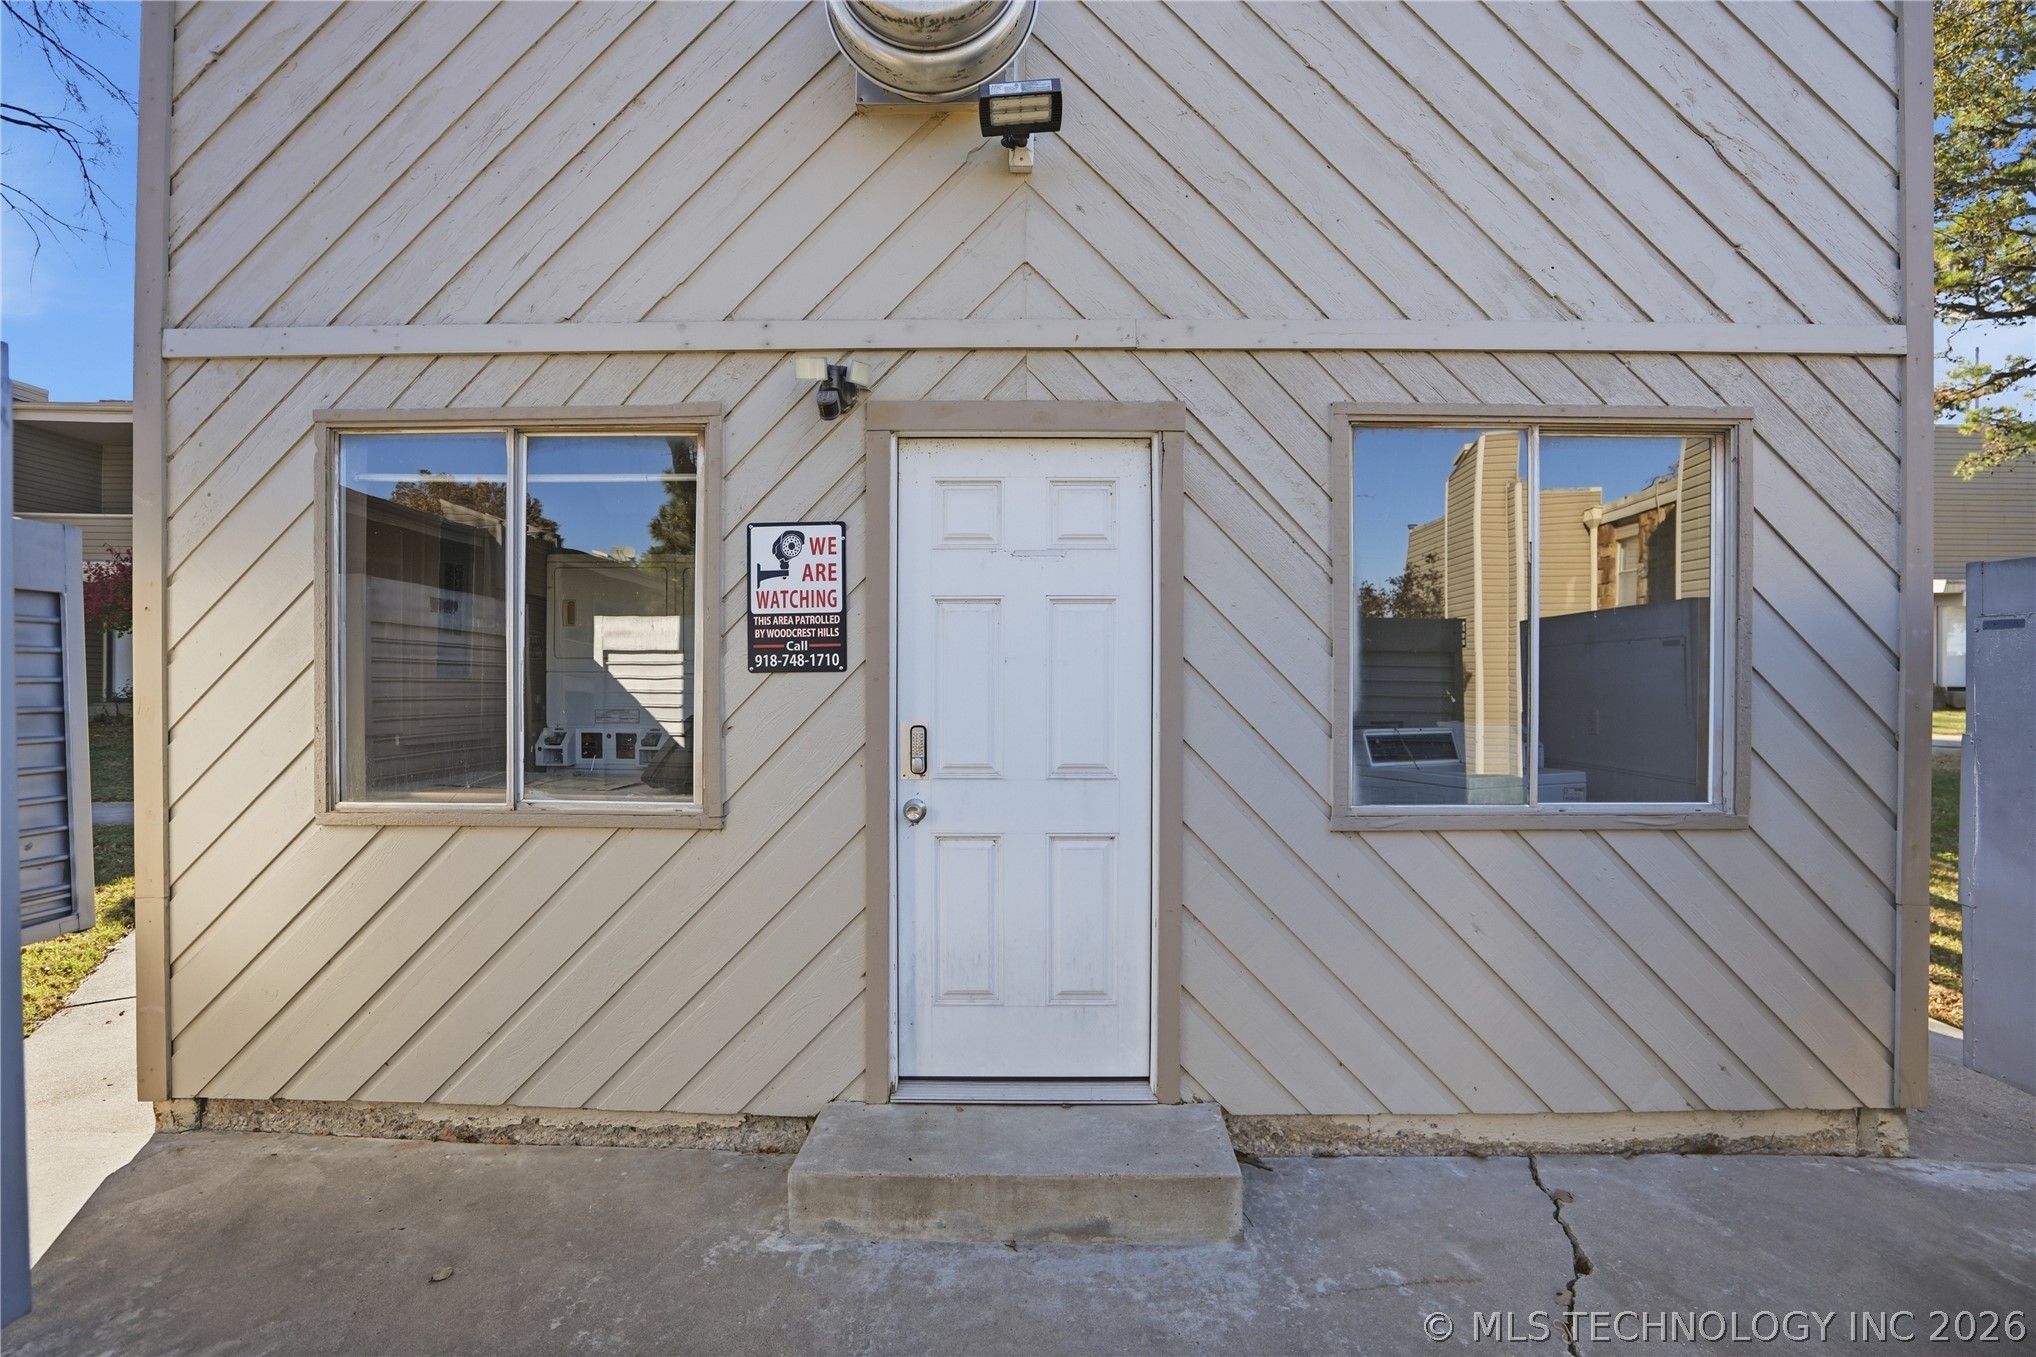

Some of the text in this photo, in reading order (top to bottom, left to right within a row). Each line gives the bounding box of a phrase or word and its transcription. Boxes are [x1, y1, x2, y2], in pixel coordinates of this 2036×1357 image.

[810, 537, 837, 555] WE
[802, 563, 837, 581] ARE
[756, 589, 837, 608] WATCHING
[754, 615, 840, 626] THIS AREA PATROLLED
[755, 628, 839, 638] BY WOODCREST HILLS
[786, 641, 808, 651] Call
[755, 653, 839, 667] 918-748-1710
